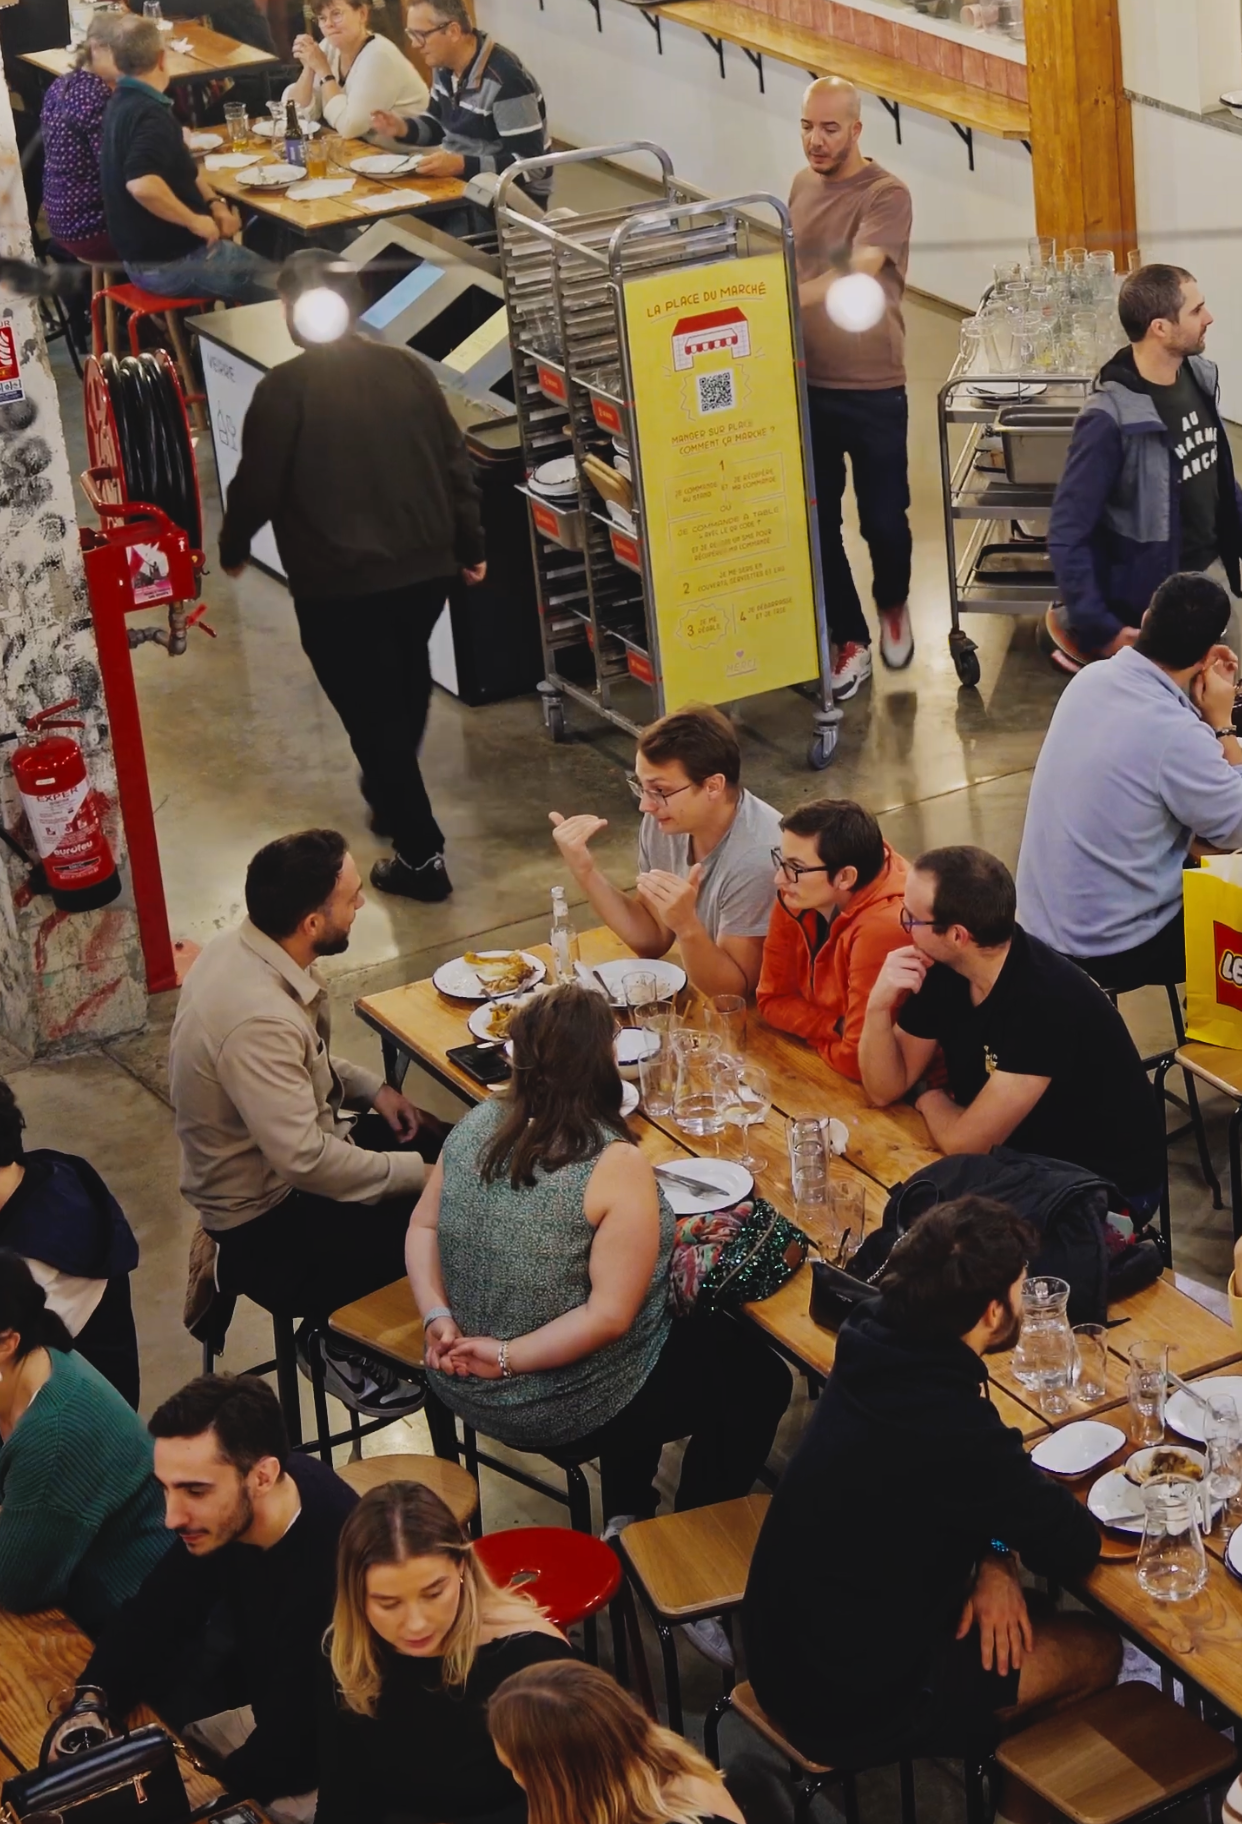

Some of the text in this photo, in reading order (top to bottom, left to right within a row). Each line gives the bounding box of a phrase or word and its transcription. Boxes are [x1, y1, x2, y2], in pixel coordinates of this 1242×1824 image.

[647, 282, 766, 318] LA PLACE DU MARCHÉ
[1182, 411, 1199, 432] AU
[671, 430, 706, 445] MANGER
[709, 425, 725, 437] SUR
[679, 438, 720, 455] COMMENT
[722, 436, 732, 447] ÇA
[735, 428, 767, 442] MARCHE
[719, 460, 725, 472] 1
[684, 482, 718, 495] COMMANDE
[743, 476, 776, 489] COMMANDE
[720, 504, 732, 512] OU
[692, 516, 740, 533] COMMANDE
[752, 506, 779, 517] TABLE
[683, 582, 690, 594] 2
[740, 611, 748, 622] 4
[687, 624, 695, 637] 3
[726, 658, 757, 672] MERCI
